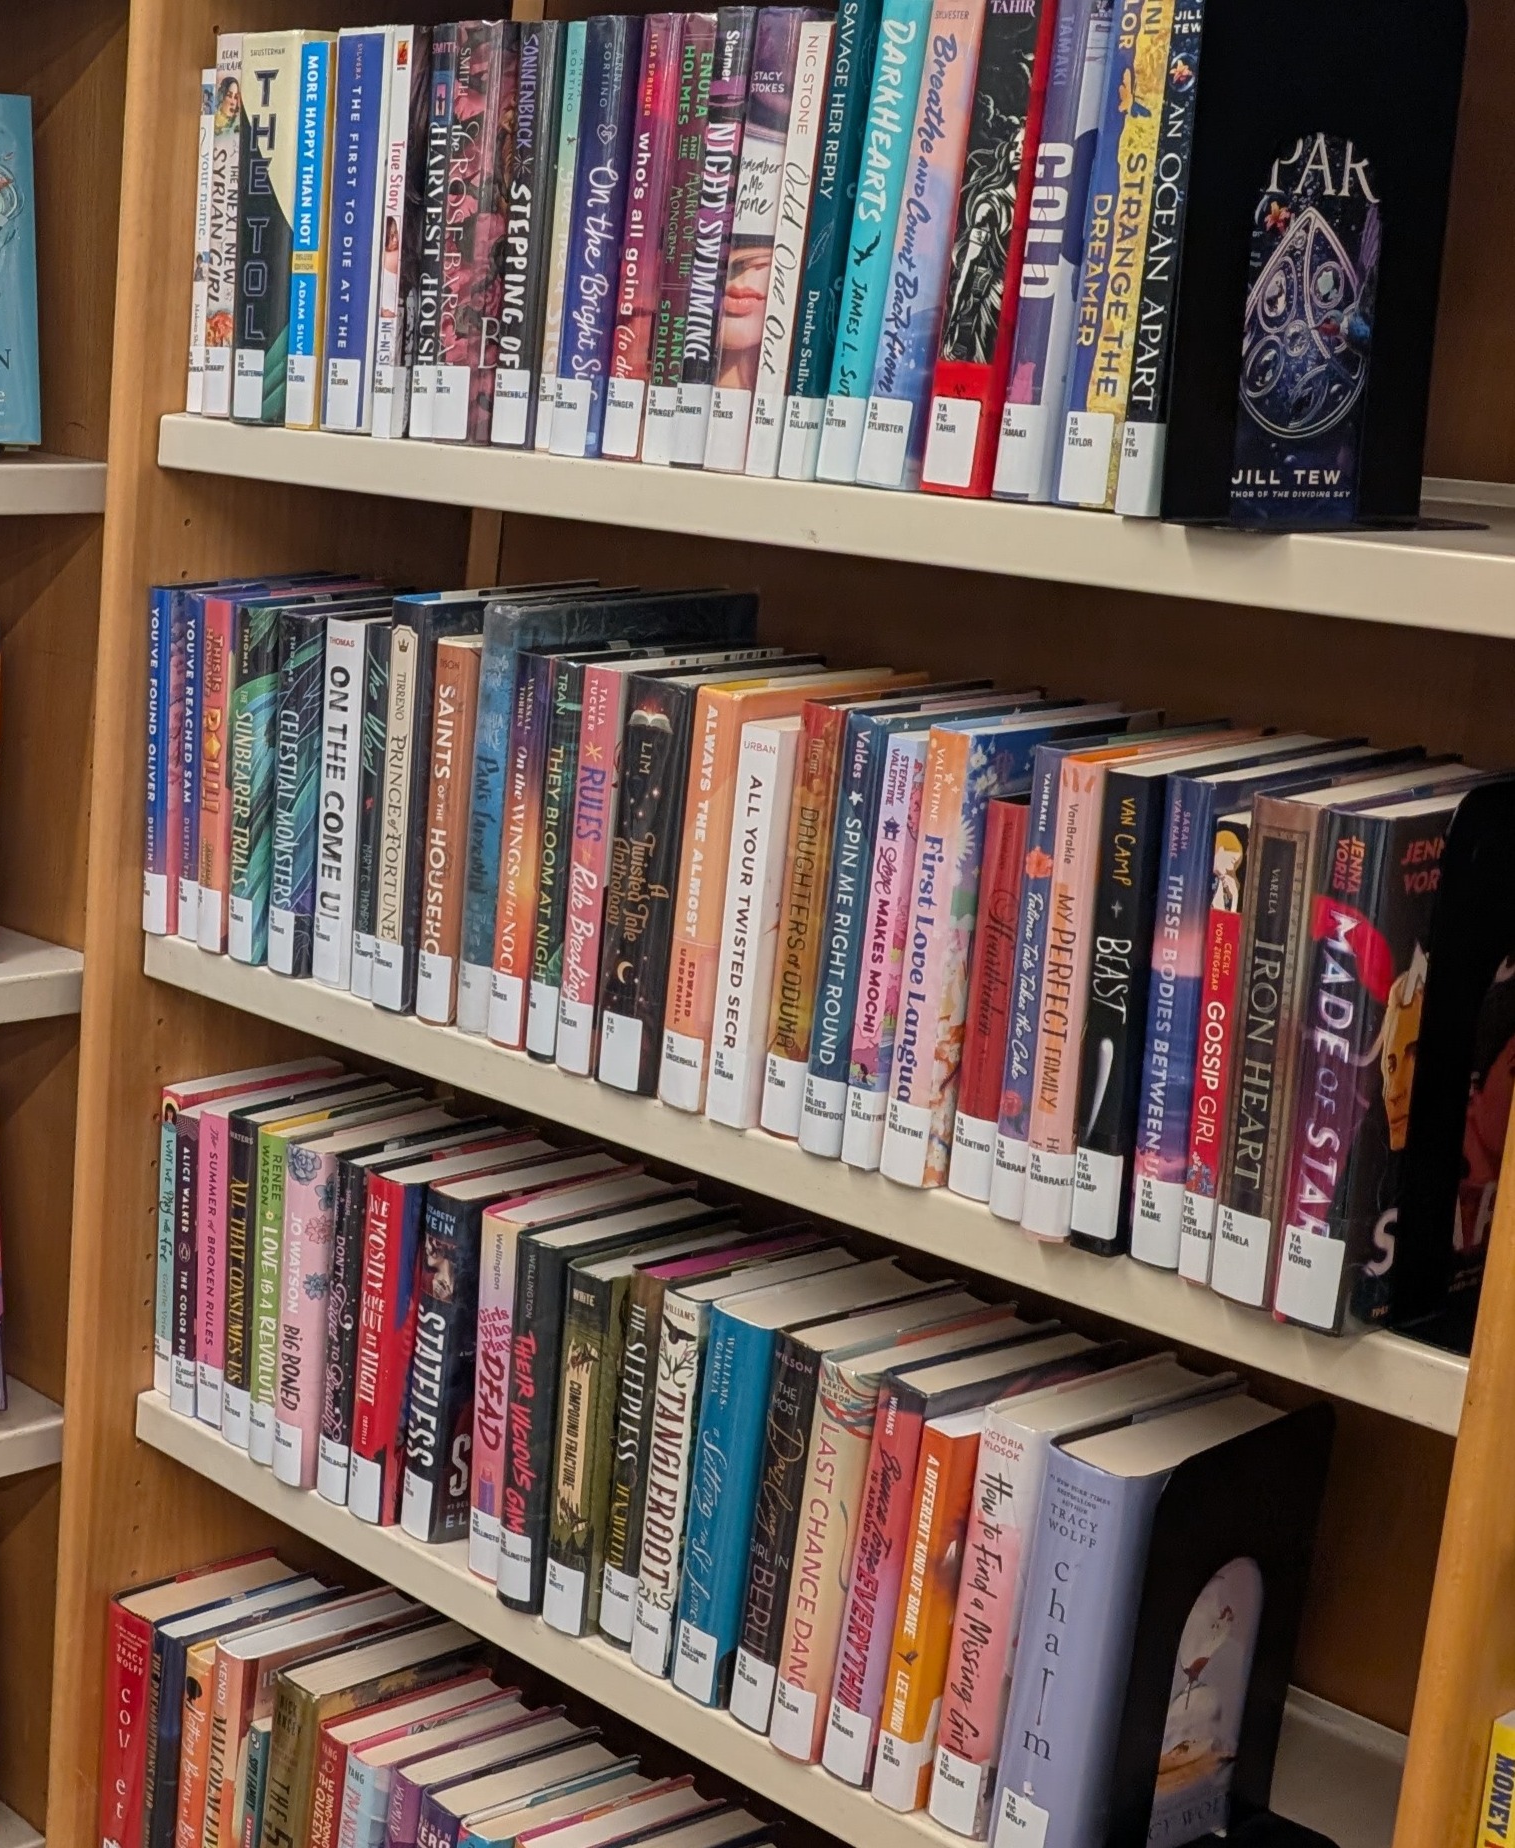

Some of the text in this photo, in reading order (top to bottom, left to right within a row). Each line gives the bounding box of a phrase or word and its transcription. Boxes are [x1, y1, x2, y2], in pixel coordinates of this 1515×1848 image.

[300, 55, 319, 246] MORE HAPPY THAN NOT
[751, 80, 784, 93] STOKES
[754, 70, 782, 81] STACY
[797, 35, 819, 136] NIC STONE
[858, 20, 915, 223] DARKHEARTS
[338, 86, 361, 349] THE FIRST TO DIE AT THE
[386, 141, 404, 211] True Story
[1075, 194, 1114, 346] DREAMER
[1095, 152, 1147, 397] STRANGE THE
[1131, 102, 1183, 409] AN OCEAN APART
[1231, 468, 1341, 486] JILL TEW
[147, 608, 159, 802] YOU'VE FOUND OLIVER
[320, 666, 351, 881] ON THE COME
[387, 733, 408, 817] PRINCE
[381, 833, 405, 938] FORTUNE
[729, 774, 763, 990] ALL YOUR TWISTED
[819, 816, 862, 1066] SPIN ME RIGHT ROUND
[912, 833, 944, 984] First Love
[1092, 937, 1133, 1025] BEAST
[1195, 1000, 1225, 1146] GOSSIP GIRL
[1234, 937, 1284, 1190] IRON HEART
[279, 1323, 301, 1412] BIG BONED
[642, 1386, 687, 1593] TANGLEROOT
[1048, 1518, 1098, 1549] WOLFF
[1050, 1503, 1099, 1533] TRACY
[1023, 1560, 1070, 1761] charm
[1488, 1753, 1515, 1838] MONEY
